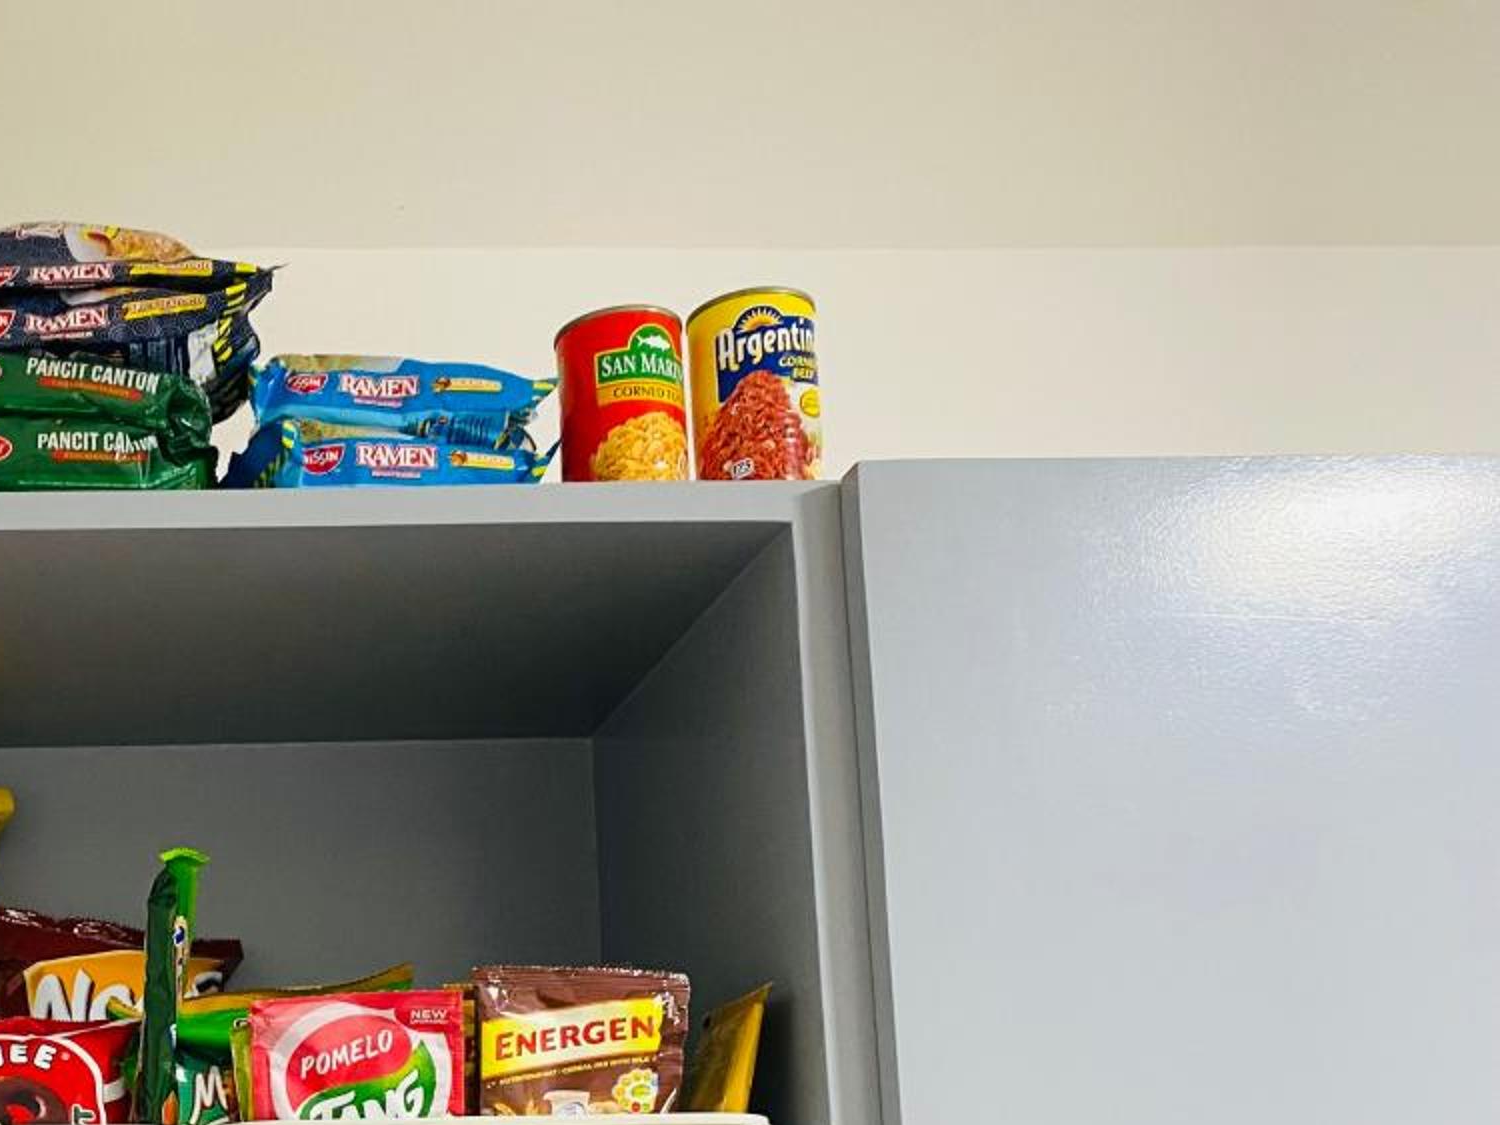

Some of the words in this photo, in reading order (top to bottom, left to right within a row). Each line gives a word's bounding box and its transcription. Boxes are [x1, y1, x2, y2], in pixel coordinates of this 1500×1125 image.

[30, 263, 113, 282] RAMEN
[25, 306, 110, 333] RAMEN
[27, 357, 88, 379] PANCIT
[91, 365, 160, 394] CANTON
[602, 354, 636, 377] SAN
[339, 373, 420, 398] RAMEN
[37, 432, 99, 450] PANCIT
[356, 442, 438, 469] RAMEN
[411, 1008, 448, 1020] NEW
[495, 1014, 655, 1061] ENERGEN
[300, 1028, 394, 1080] POMELO
